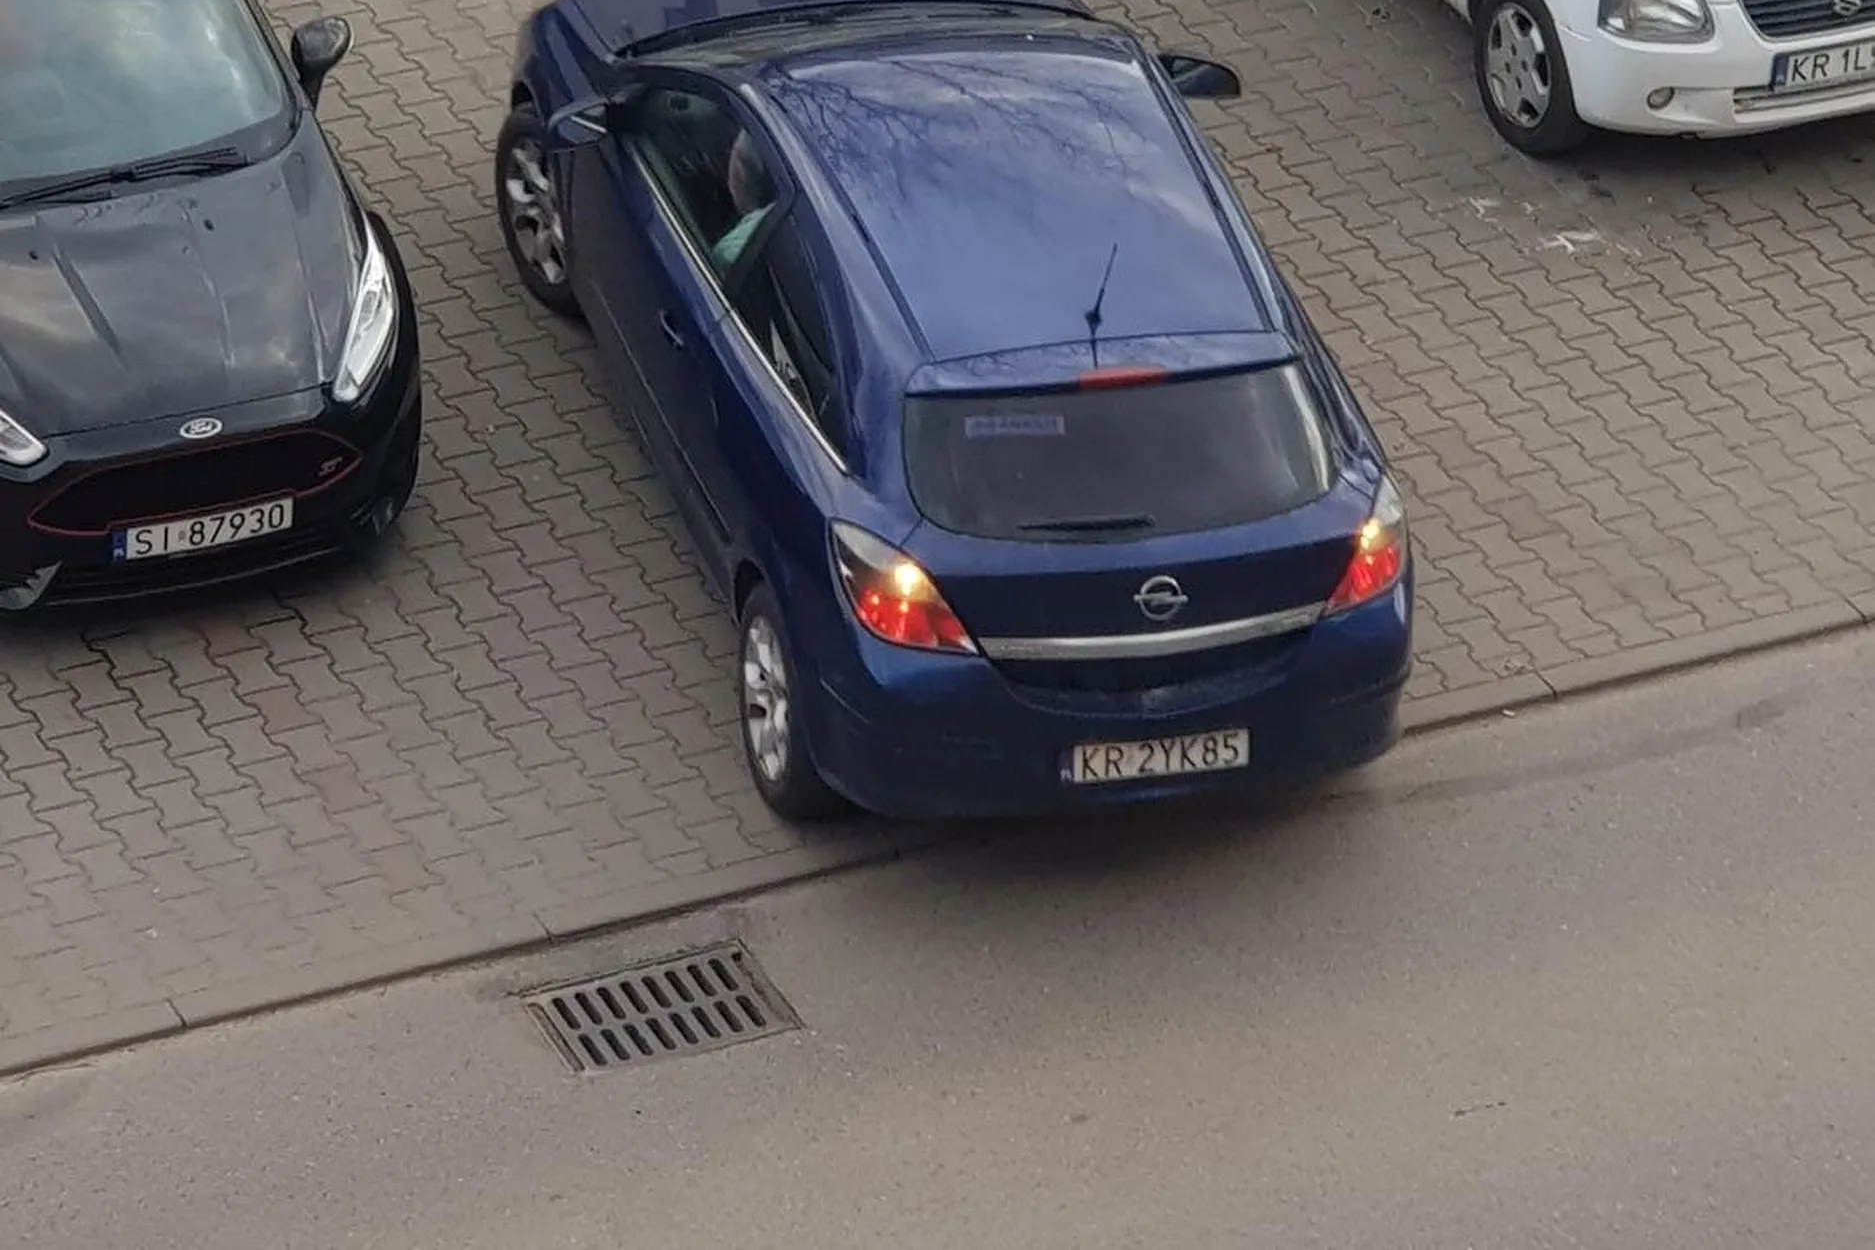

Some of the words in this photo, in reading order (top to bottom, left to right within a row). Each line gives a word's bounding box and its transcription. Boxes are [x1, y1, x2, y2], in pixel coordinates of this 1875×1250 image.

[1791, 53, 1830, 82] KR
[1842, 44, 1875, 73] 1L
[135, 526, 170, 555] SI
[189, 503, 285, 546] 87930
[1082, 745, 1125, 779] KR
[1137, 732, 1240, 775] 2YK85
